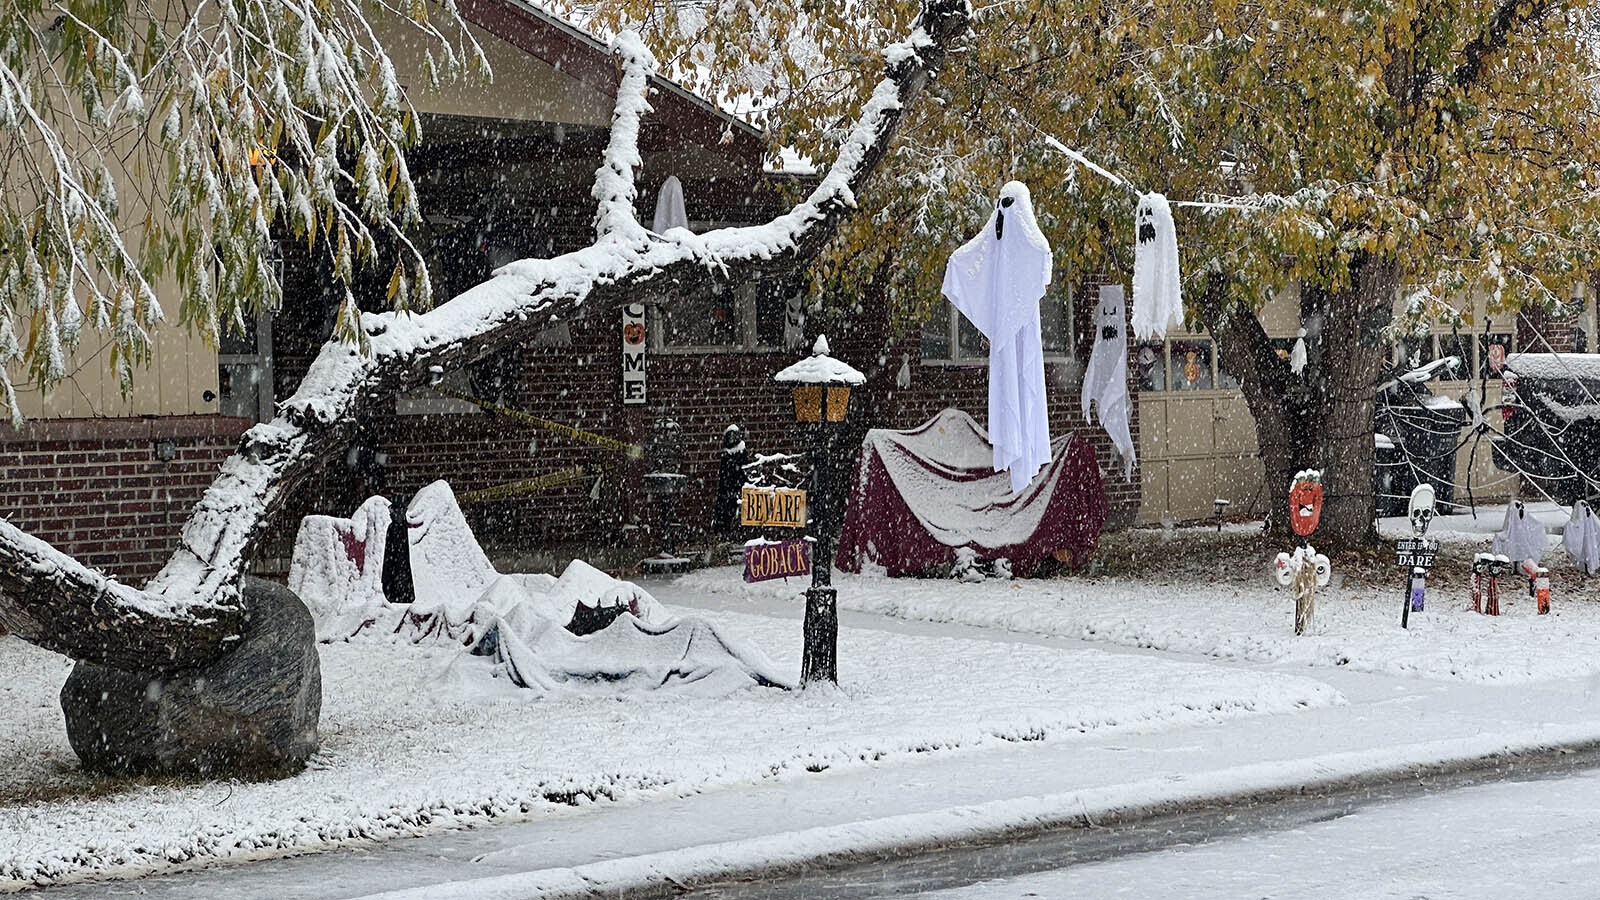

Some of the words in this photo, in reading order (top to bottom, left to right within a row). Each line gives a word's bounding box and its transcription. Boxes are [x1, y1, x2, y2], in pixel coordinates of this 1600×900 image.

[747, 493, 802, 522] BEWARE
[1397, 541, 1417, 550] ENTER
[1398, 555, 1432, 566] DARE
